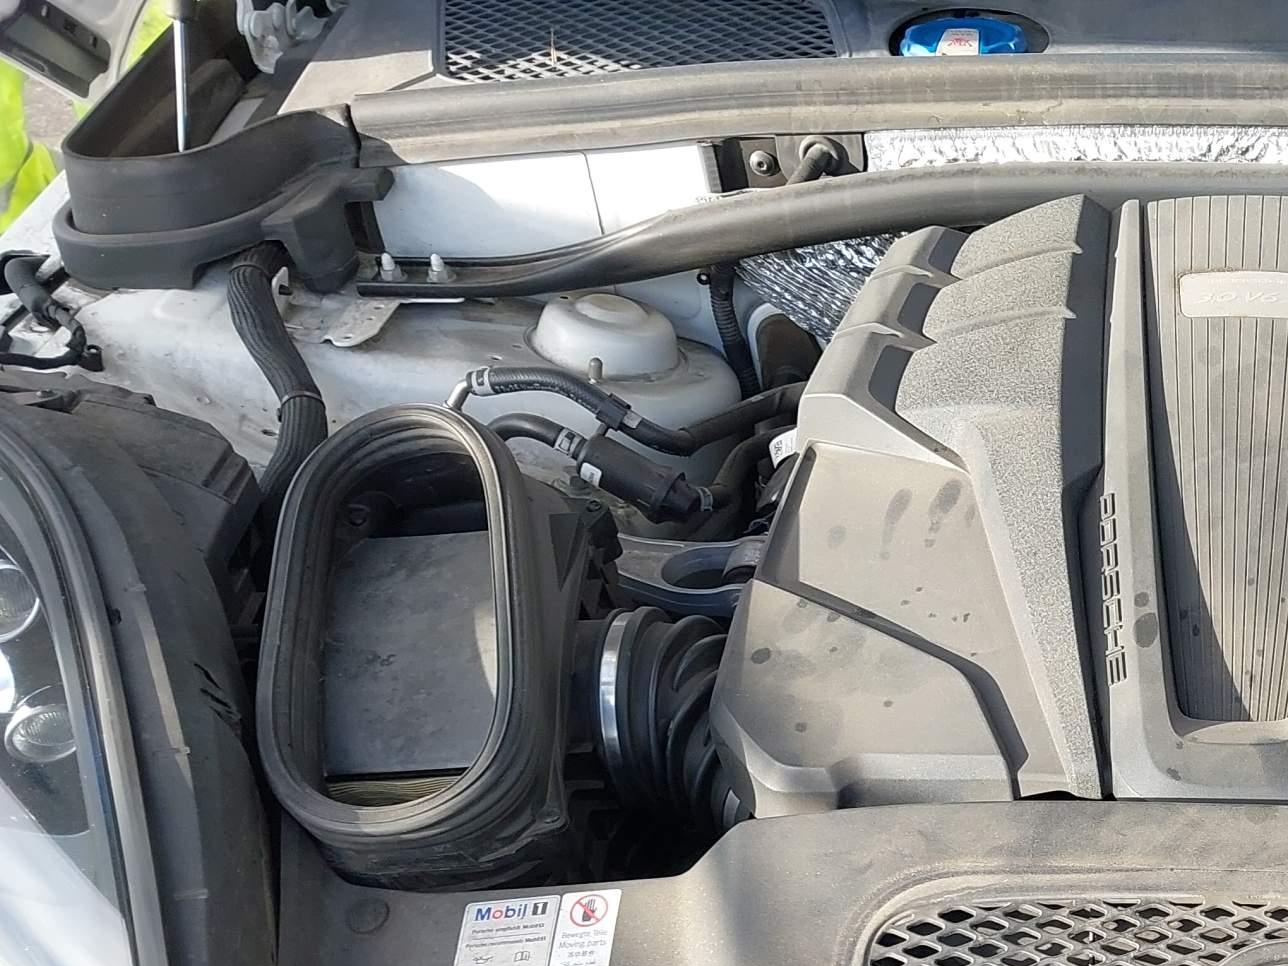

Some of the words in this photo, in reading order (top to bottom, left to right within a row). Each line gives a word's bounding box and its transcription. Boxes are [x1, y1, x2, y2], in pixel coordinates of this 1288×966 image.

[1247, 291, 1281, 304] V6
[1100, 492, 1127, 687] PORSCHE
[474, 903, 528, 921] Mobil
[531, 901, 549, 916] 1
[558, 941, 585, 950] Moving
[586, 940, 608, 948] parts
